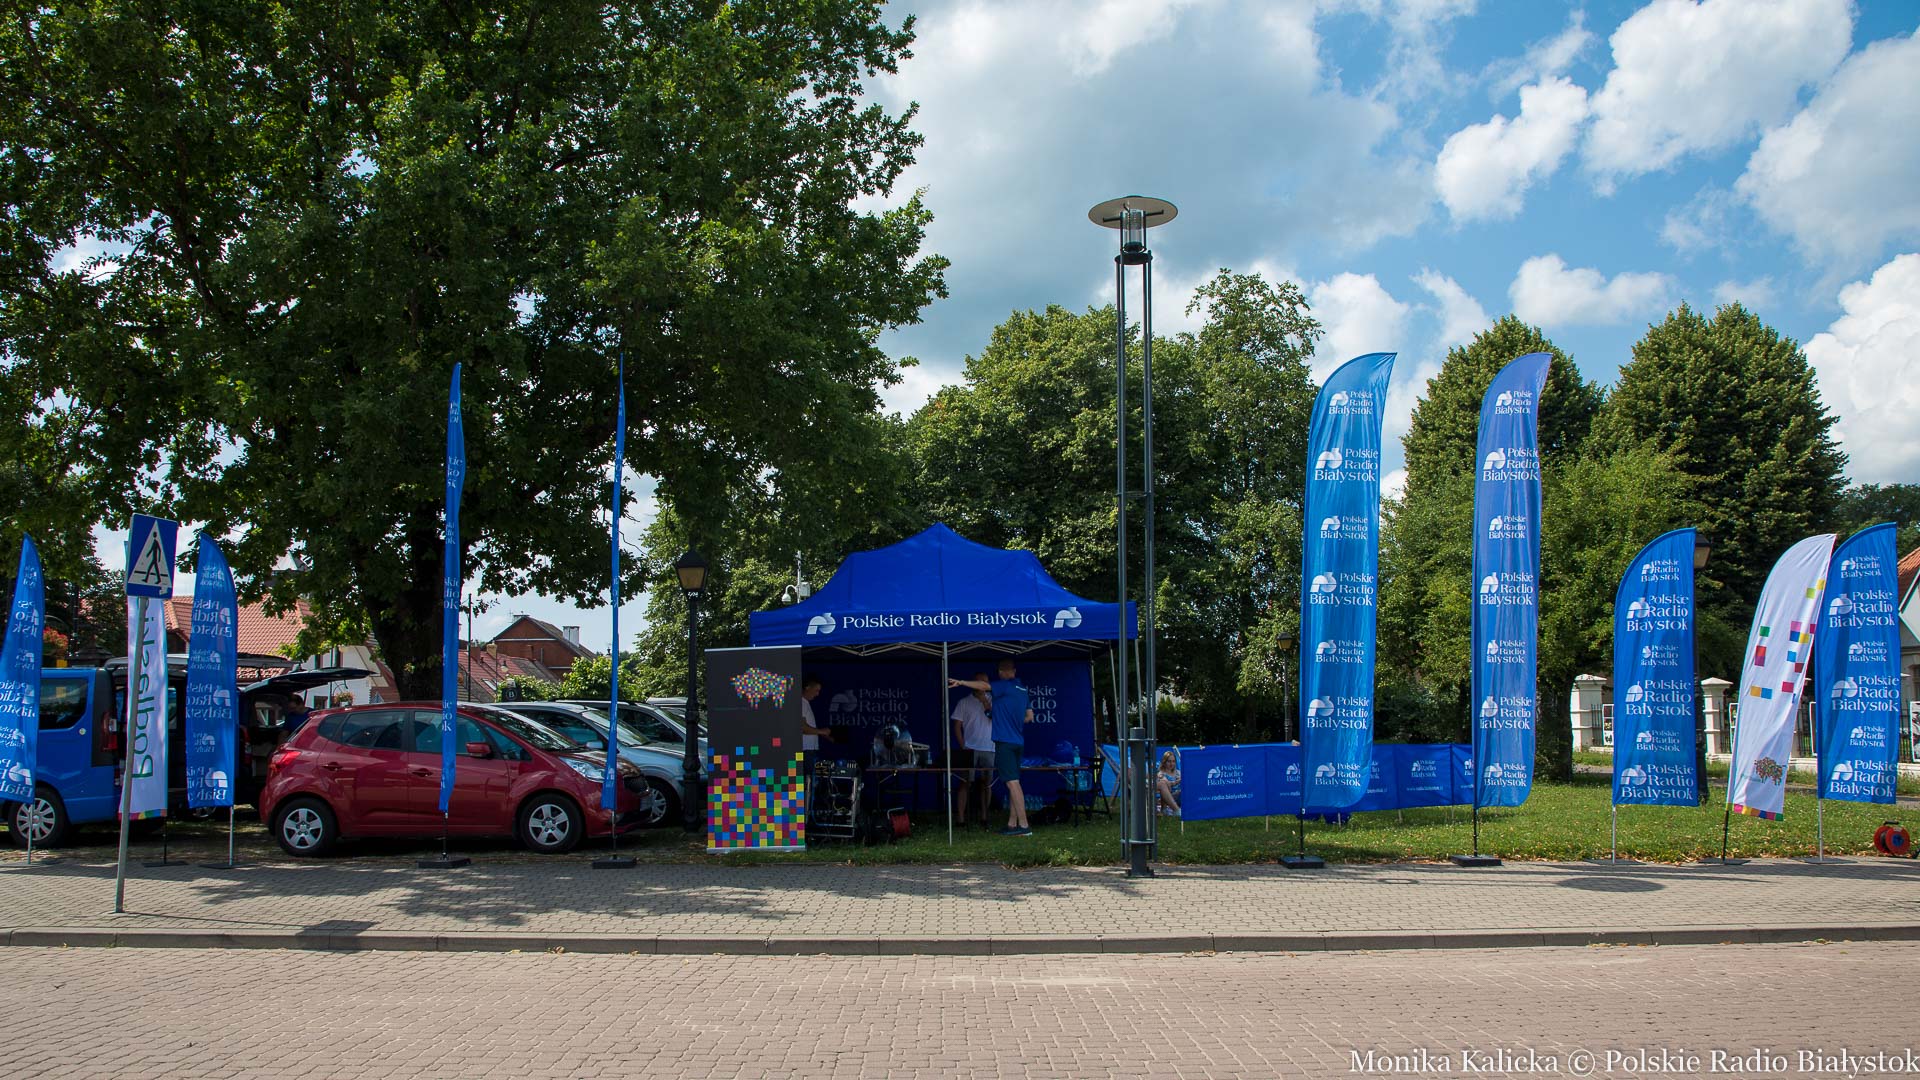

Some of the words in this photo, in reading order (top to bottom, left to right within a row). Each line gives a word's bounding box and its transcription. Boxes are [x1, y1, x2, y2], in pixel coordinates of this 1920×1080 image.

[1349, 399, 1374, 407] Radio
[1345, 448, 1379, 459] Polskie
[1344, 460, 1379, 470] Radio
[1507, 460, 1540, 470] Radio
[1342, 515, 1368, 524] Polskie
[1342, 524, 1368, 532] Radio
[1503, 523, 1526, 531] Radio
[1340, 572, 1375, 584] Polskie
[1501, 572, 1534, 582] Polskie
[1339, 584, 1374, 595] Radio
[1500, 583, 1534, 594] Radio
[1648, 604, 1688, 617] Radio
[1853, 601, 1893, 613] Radio
[842, 614, 905, 629] Polskie
[910, 612, 961, 627] Radio
[967, 611, 1047, 628] Białystok
[1338, 640, 1365, 648] Polskie
[1500, 640, 1526, 648] Polskie
[1500, 647, 1526, 655] Radio
[1651, 651, 1679, 659] Radio
[1644, 679, 1691, 690] Polskie
[1858, 675, 1900, 686] Polskie
[859, 688, 909, 699] Polskie
[1029, 685, 1057, 696] skie
[1858, 686, 1900, 699] Radio
[1337, 696, 1369, 707] Polskie
[1500, 696, 1532, 707] Polskie
[1644, 690, 1692, 703] Radio
[859, 700, 909, 713] Radio
[1030, 697, 1057, 710] dio
[1337, 707, 1369, 718] Radio
[1500, 707, 1532, 718] Radio
[1863, 732, 1886, 740] Radio
[1647, 763, 1694, 775] Polskie
[1854, 759, 1897, 772] Polskie
[1220, 770, 1244, 778] Radio
[1337, 770, 1361, 779] Radio
[1503, 771, 1527, 779] Radio
[1854, 771, 1896, 783] Radio
[1648, 774, 1694, 787] Radio
